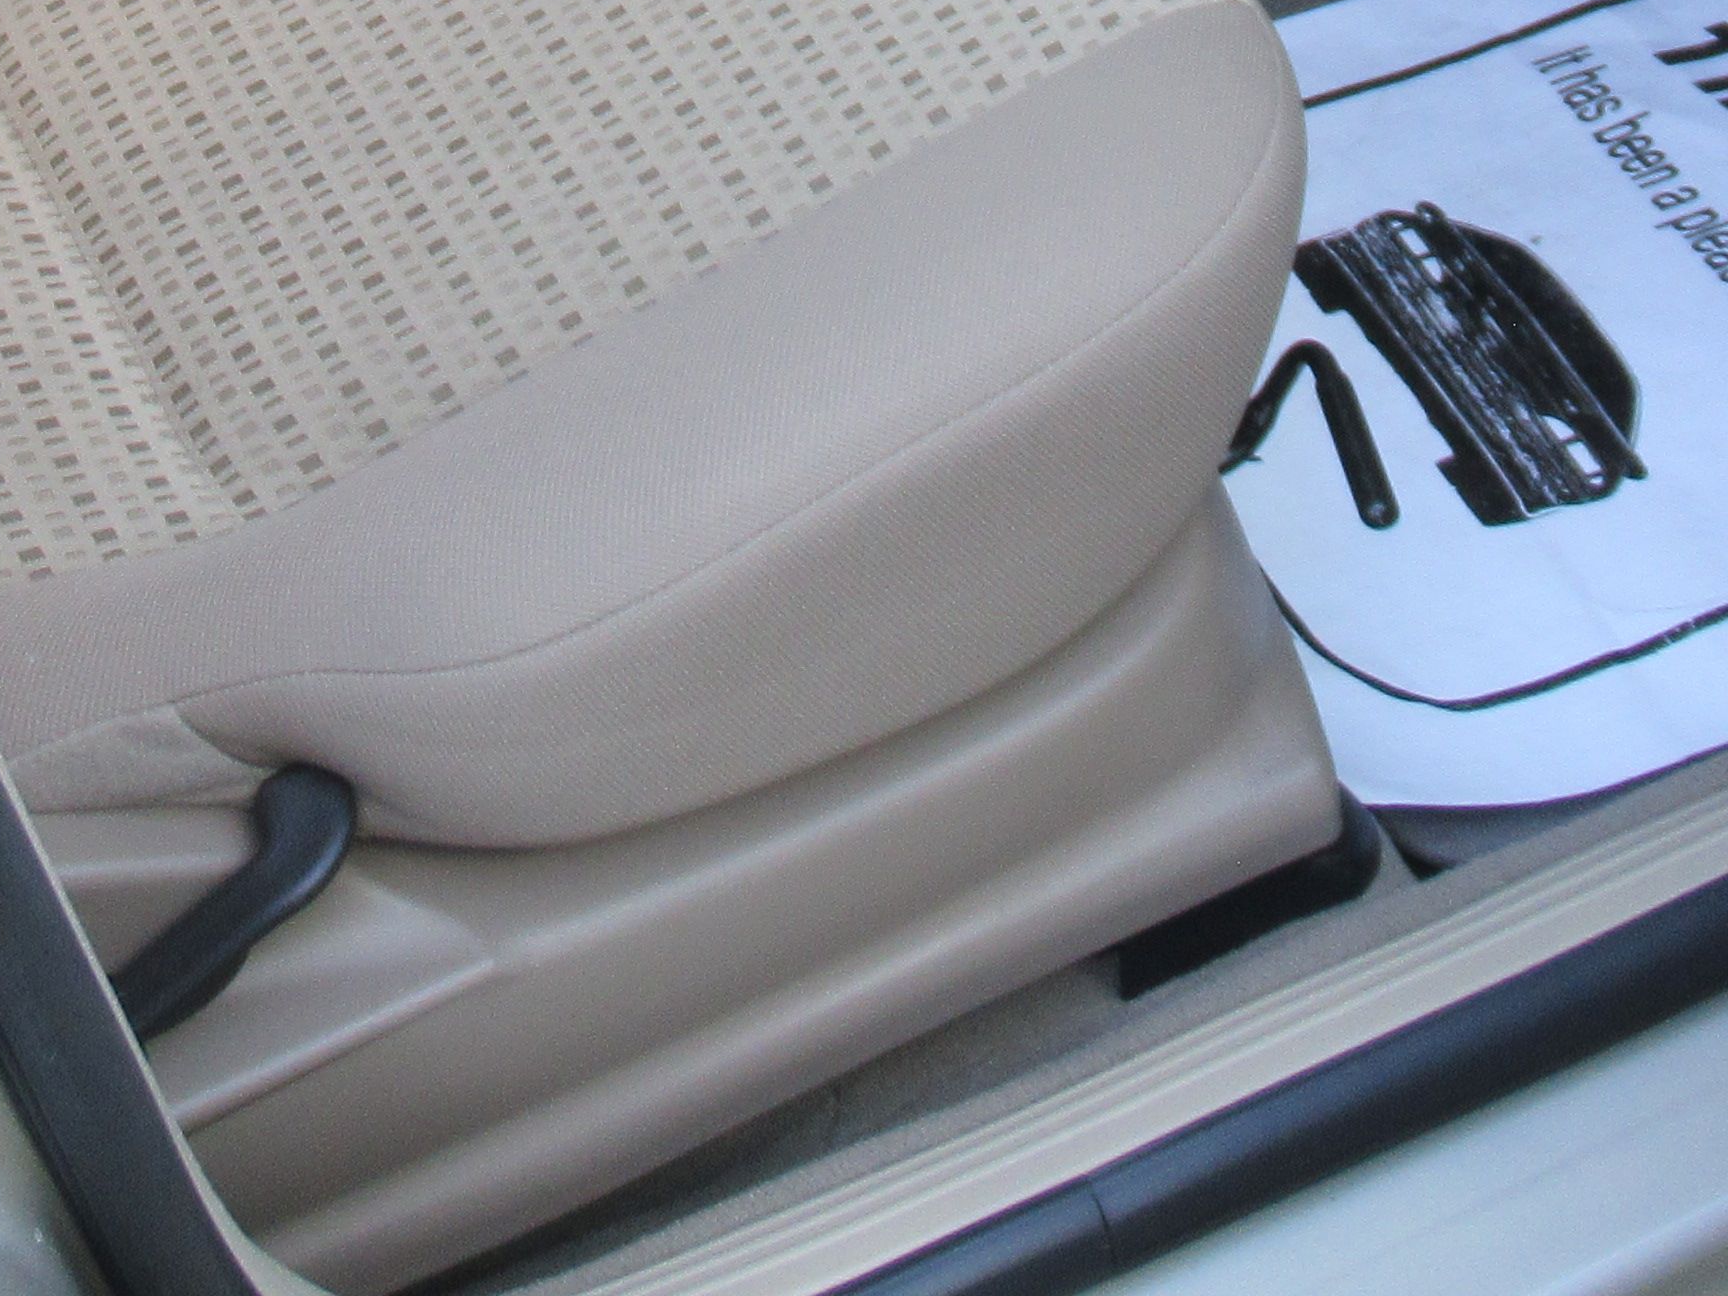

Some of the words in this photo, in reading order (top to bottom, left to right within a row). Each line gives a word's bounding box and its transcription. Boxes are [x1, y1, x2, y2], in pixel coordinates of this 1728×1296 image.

[1532, 44, 1593, 73] It
[1550, 64, 1620, 122] has
[1593, 110, 1680, 189] been
[1651, 186, 1700, 209] a
